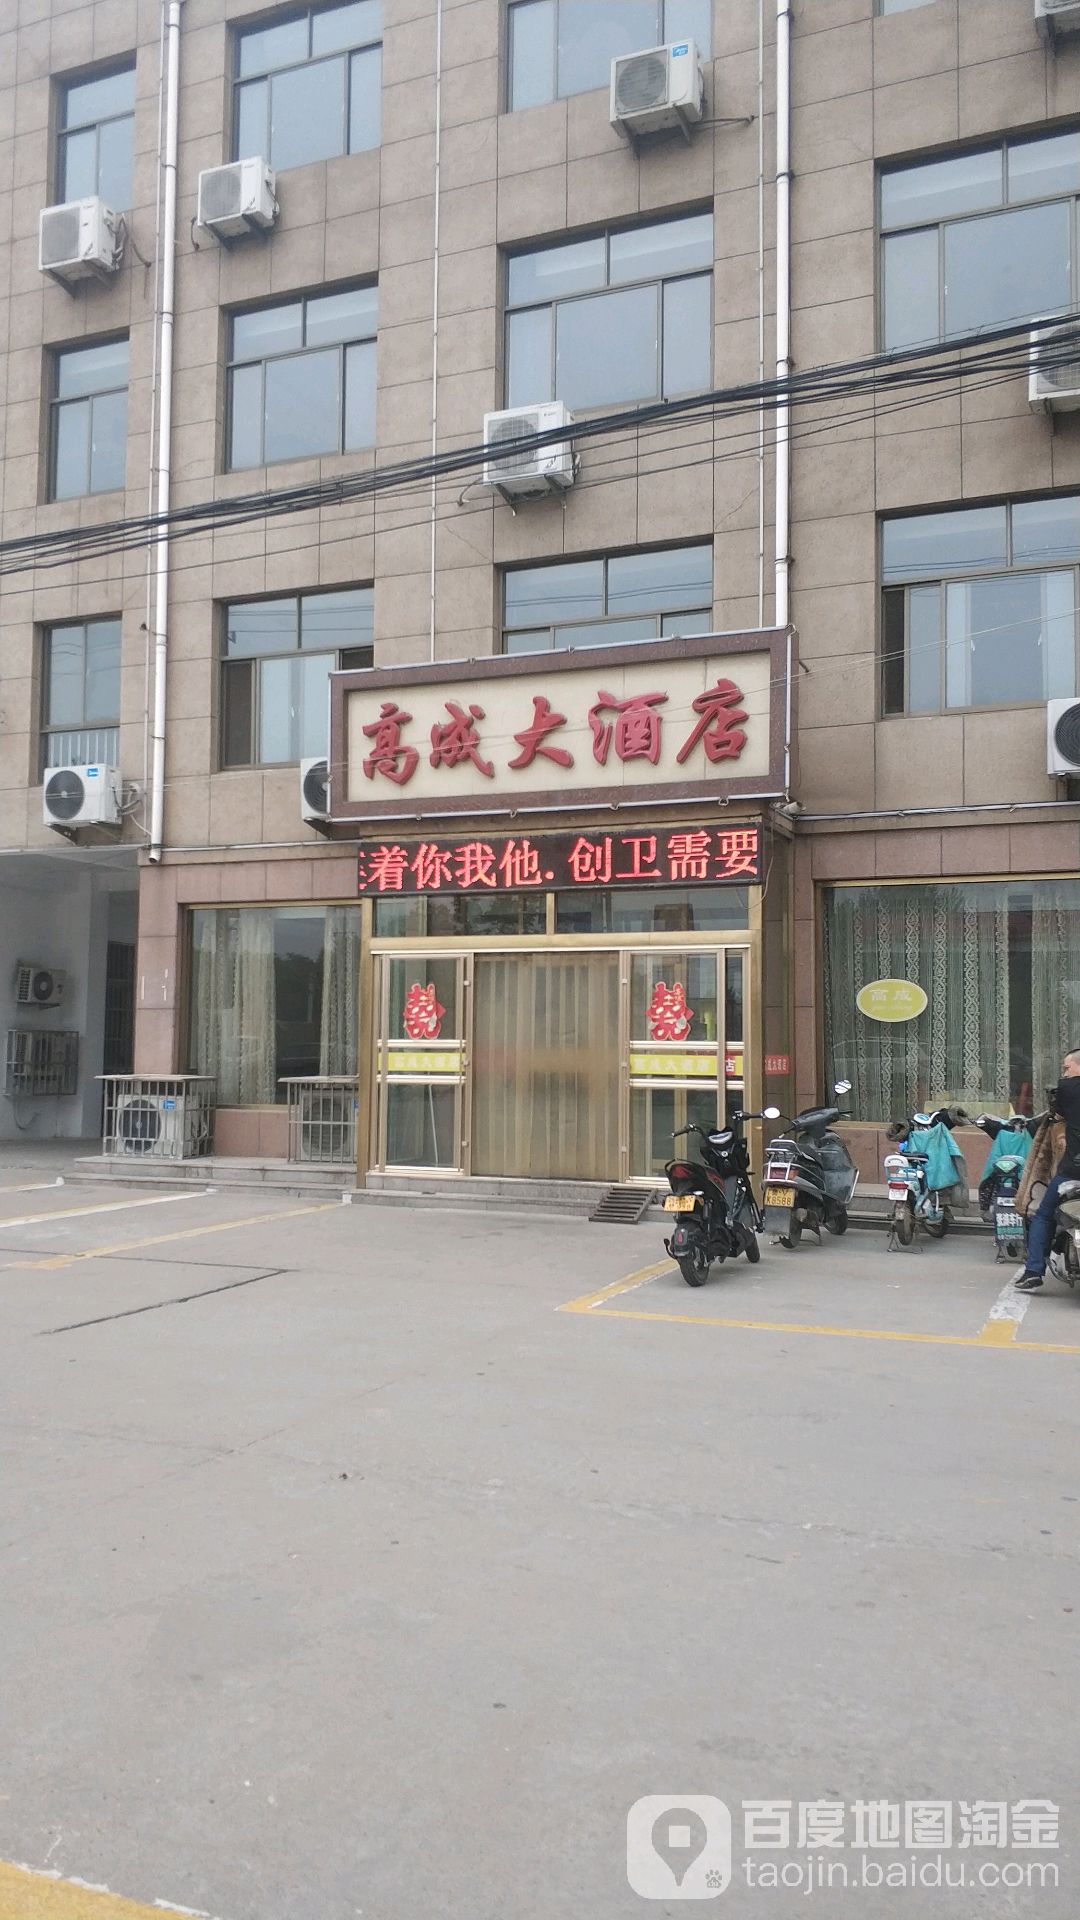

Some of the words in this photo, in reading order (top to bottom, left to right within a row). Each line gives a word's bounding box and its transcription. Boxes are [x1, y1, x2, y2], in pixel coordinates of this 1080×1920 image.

[361, 678, 750, 786] 高成大酒店
[359, 828, 759, 892] 着你我他.创卫需要
